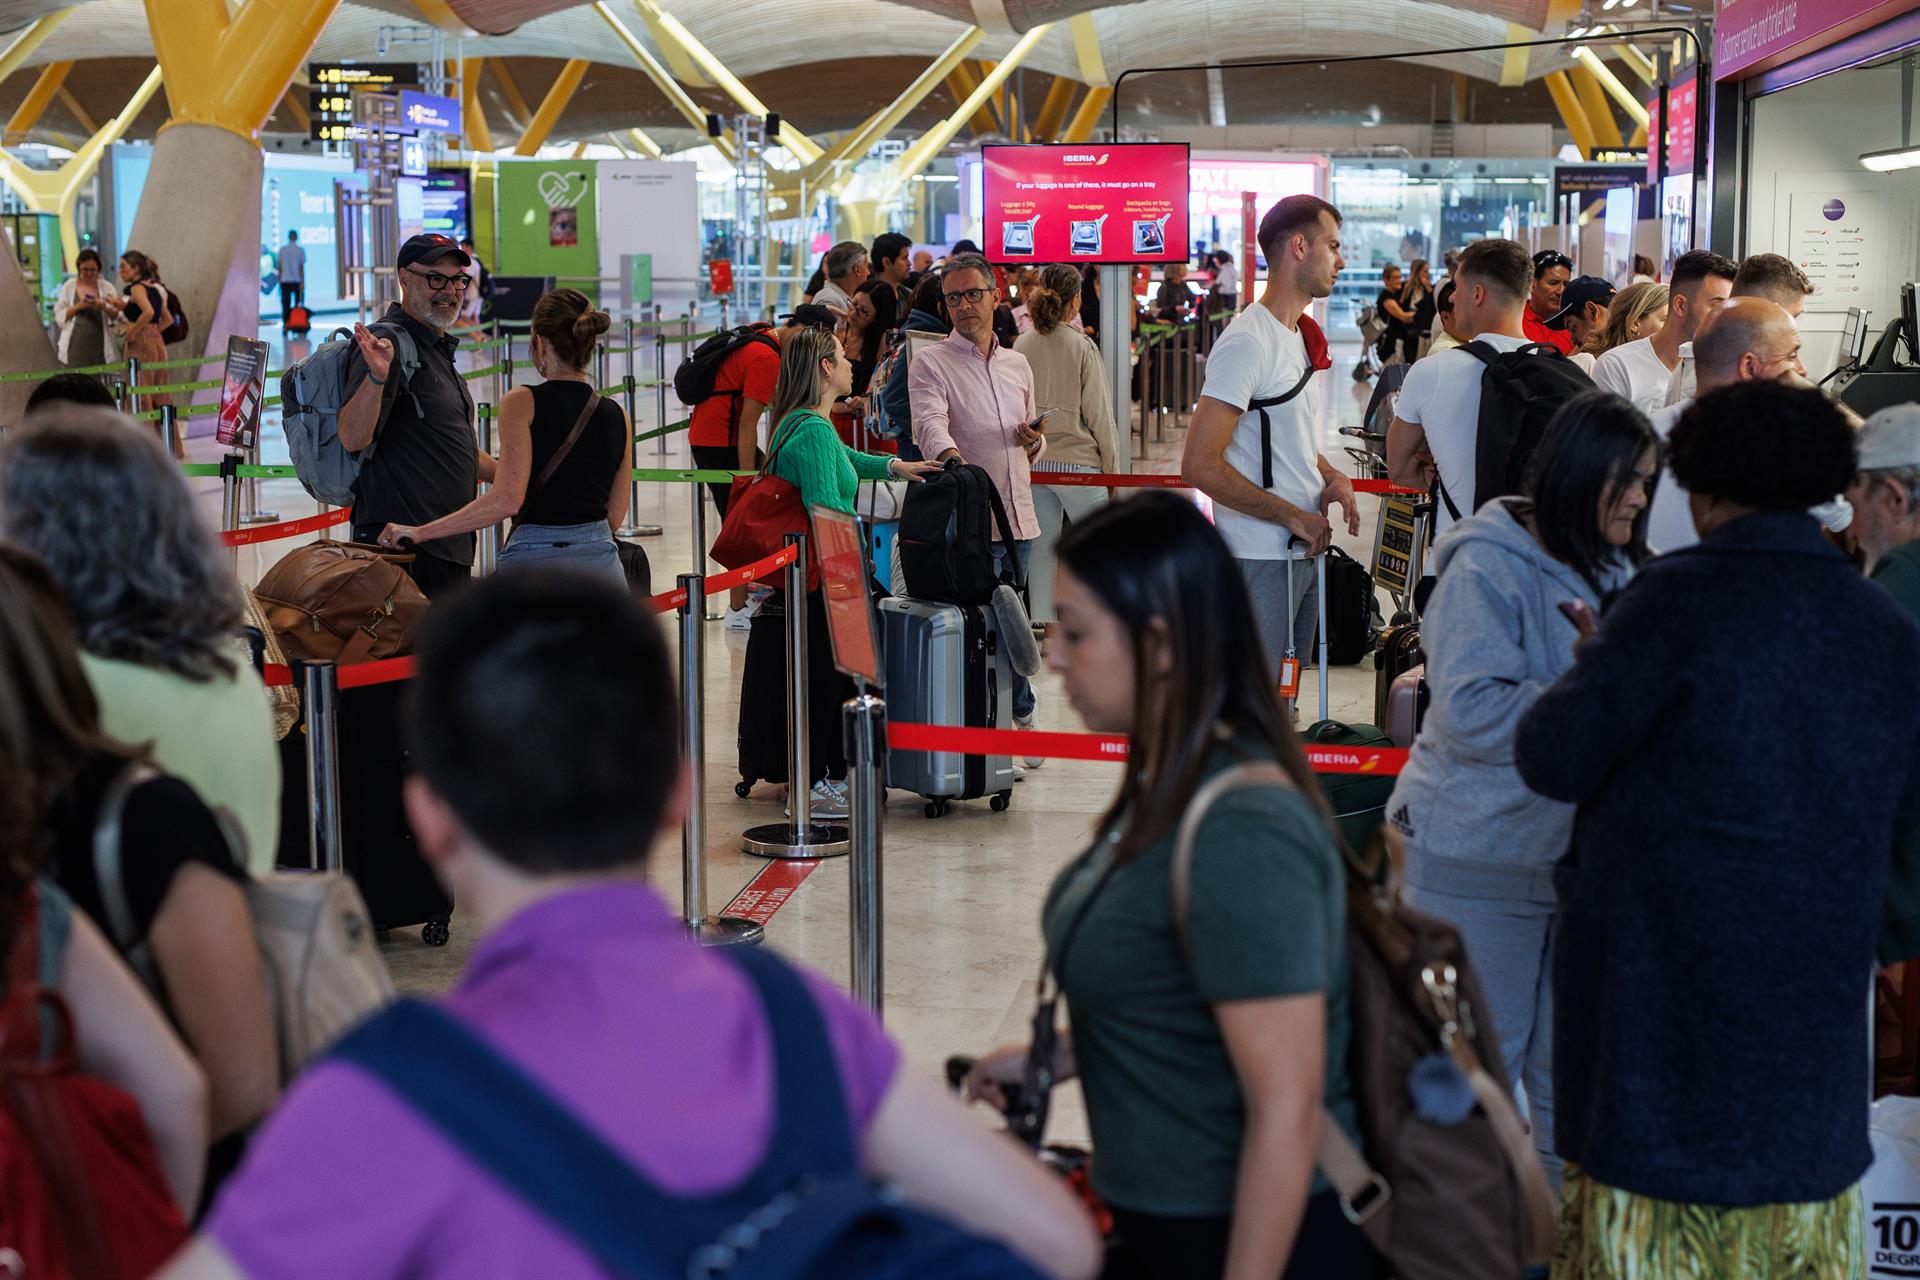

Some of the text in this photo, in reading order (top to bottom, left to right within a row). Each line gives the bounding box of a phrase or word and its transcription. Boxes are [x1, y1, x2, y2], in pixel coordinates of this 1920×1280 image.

[1719, 32, 1741, 65] Customer
[1063, 154, 1096, 162] IBERIA
[1035, 182, 1058, 190] luggage
[1100, 742, 1130, 754] IBE
[1308, 753, 1359, 765] IBERIA
